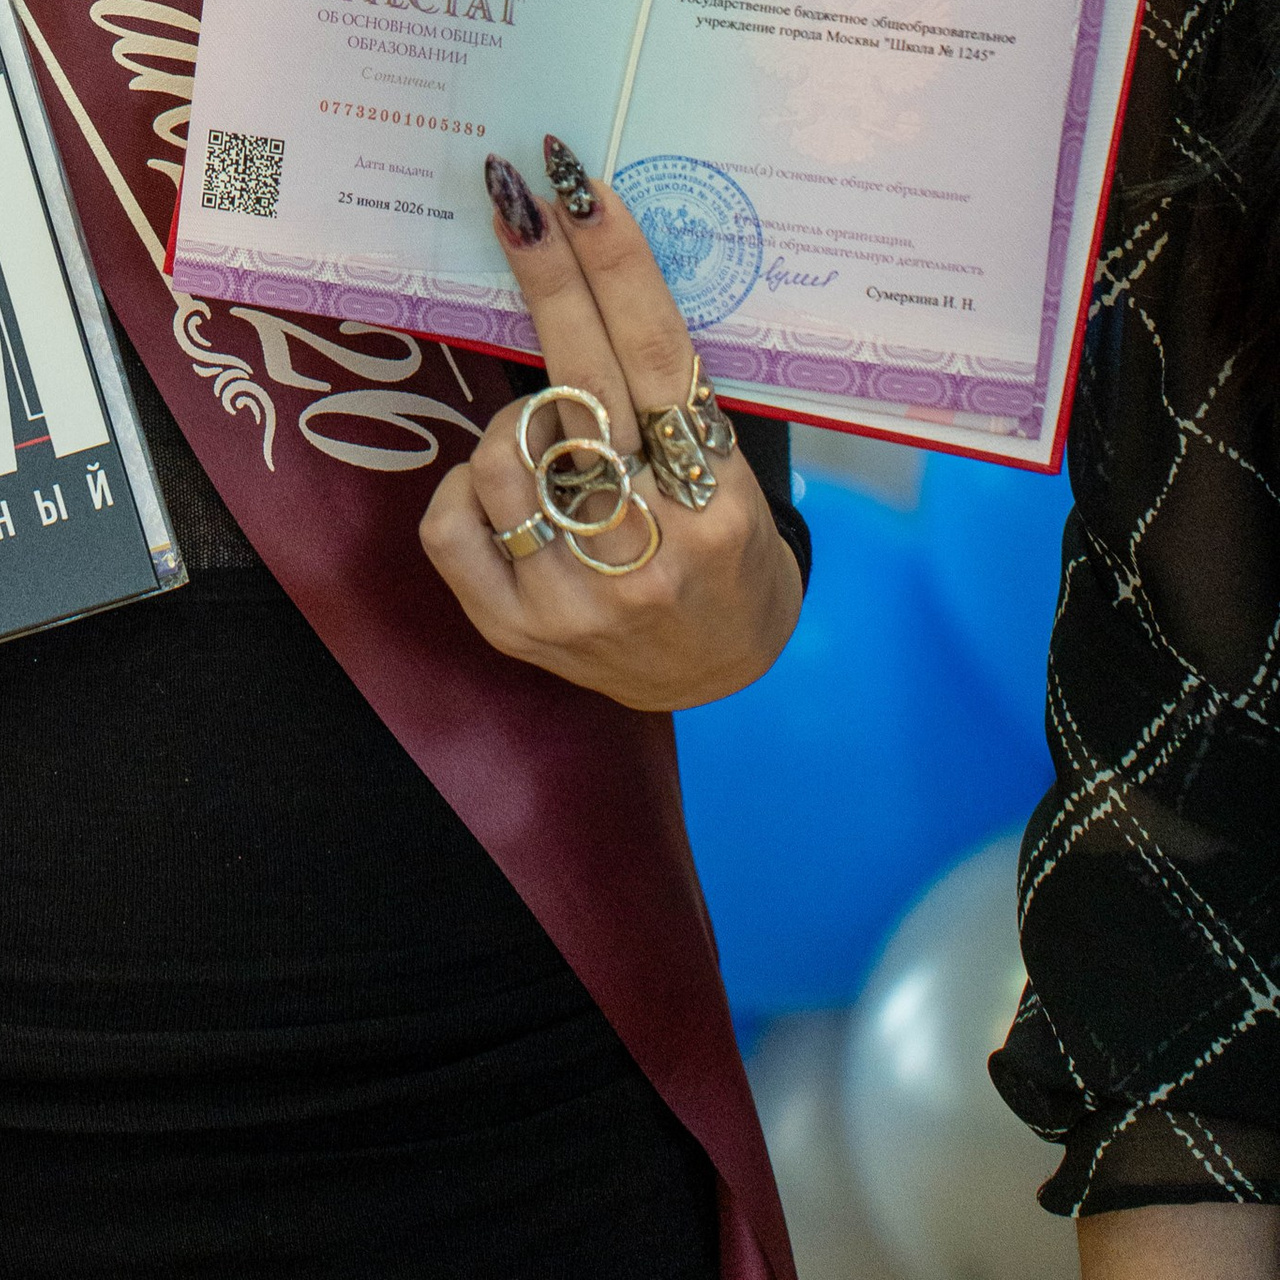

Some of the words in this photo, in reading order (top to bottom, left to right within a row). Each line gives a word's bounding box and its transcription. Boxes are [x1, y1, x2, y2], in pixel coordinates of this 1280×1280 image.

[317, 9, 339, 24] ОБ
[342, 12, 437, 39] ОСНОВНОМ
[441, 27, 503, 49] ОБЩЕМ
[695, 15, 776, 36] учреждение
[779, 27, 823, 42] города
[826, 30, 880, 49] Москвы
[884, 36, 935, 57] "Школа
[937, 44, 954, 58] №
[957, 46, 995, 62] 1245"
[794, 4, 868, 27] бюджетное
[871, 15, 1017, 44] общеобразовательное
[347, 36, 468, 65] ОБРАЗОВАНИИ
[319, 99, 486, 137] 07732001005389
[354, 155, 385, 172] Дата
[388, 164, 434, 179] выдачи
[702, 159, 773, 180] получил(а)
[775, 169, 838, 187] основное
[841, 175, 883, 194] общее
[885, 182, 971, 203] образование
[337, 191, 353, 206] 25
[356, 197, 391, 212] июня
[394, 200, 424, 216] 2026
[427, 208, 455, 222] года
[779, 238, 893, 266] образовательную
[895, 256, 984, 276] деятельность
[865, 286, 939, 308] Сумеркина
[942, 295, 959, 309] И.
[961, 298, 977, 312] Н.
